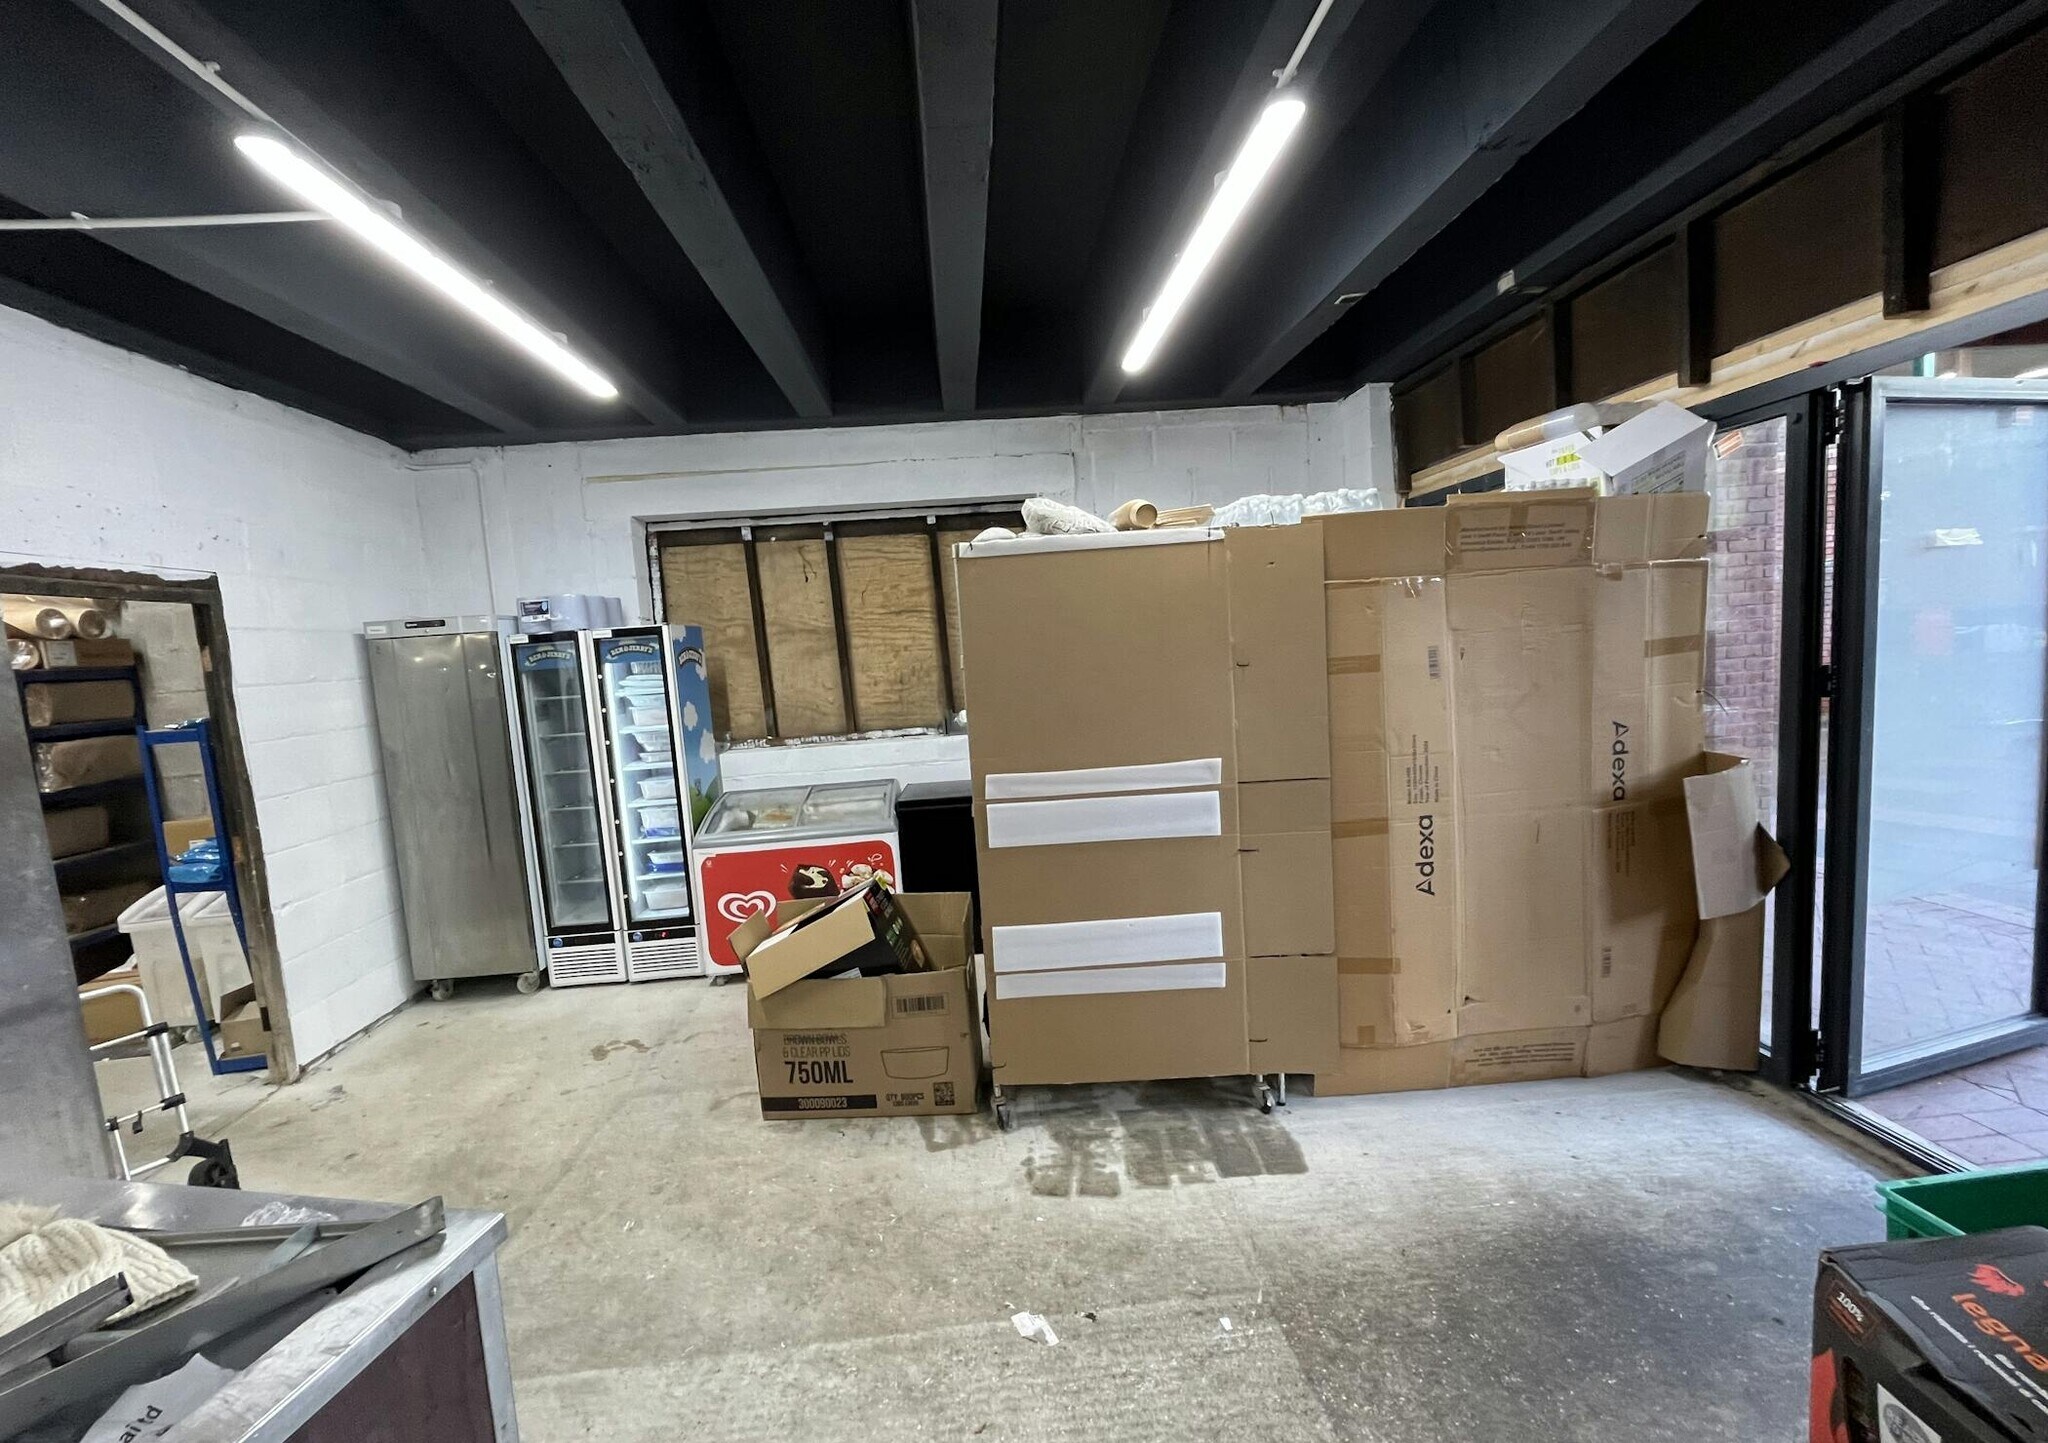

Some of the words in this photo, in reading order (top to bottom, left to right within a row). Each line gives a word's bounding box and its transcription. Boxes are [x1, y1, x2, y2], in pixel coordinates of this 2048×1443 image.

[1612, 720, 1629, 801] Adexa
[1415, 814, 1435, 896] Adexa
[784, 1060, 854, 1084] 750ML
[790, 1046, 818, 1058] CLEAR
[832, 1046, 851, 1058] LIDS
[1836, 1291, 1864, 1322] 100%
[1952, 1293, 2048, 1371] legna
